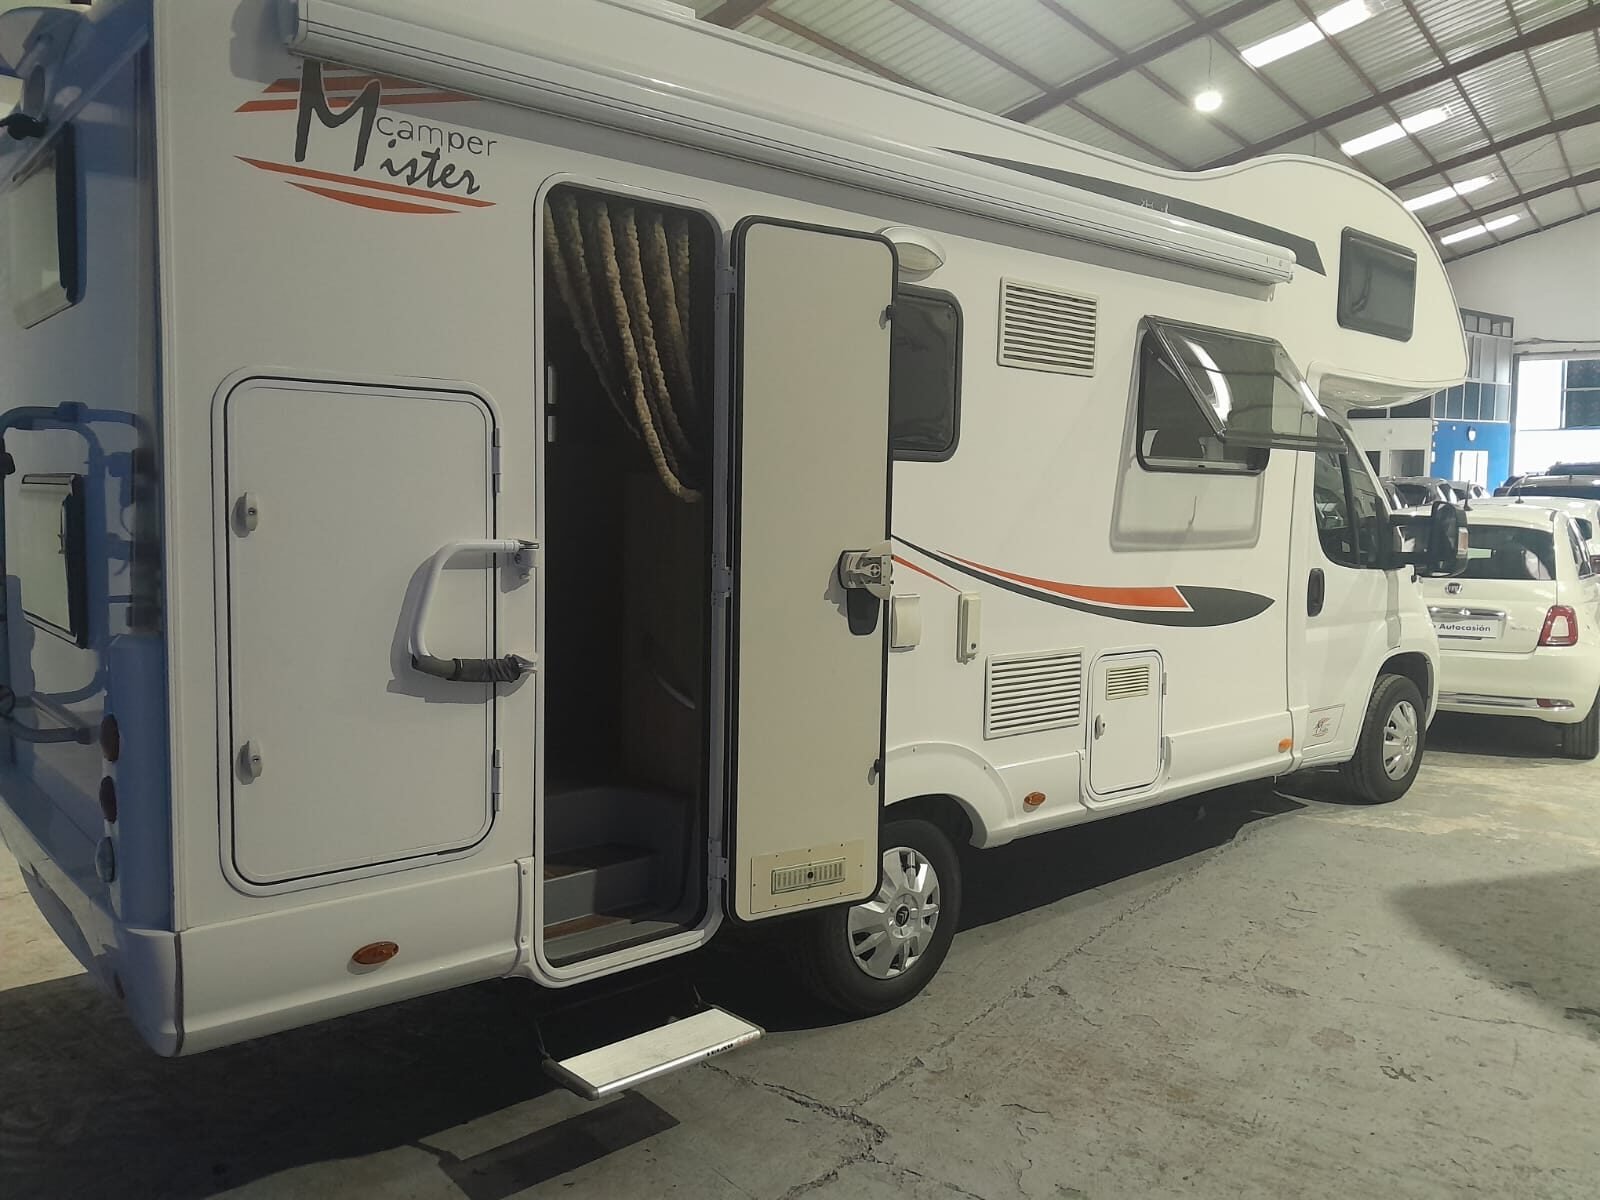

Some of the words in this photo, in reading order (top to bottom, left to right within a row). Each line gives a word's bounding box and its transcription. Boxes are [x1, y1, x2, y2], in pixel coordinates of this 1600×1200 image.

[294, 59, 481, 195] Mister
[376, 116, 498, 157] camper
[1439, 623, 1491, 632] Autocasión
